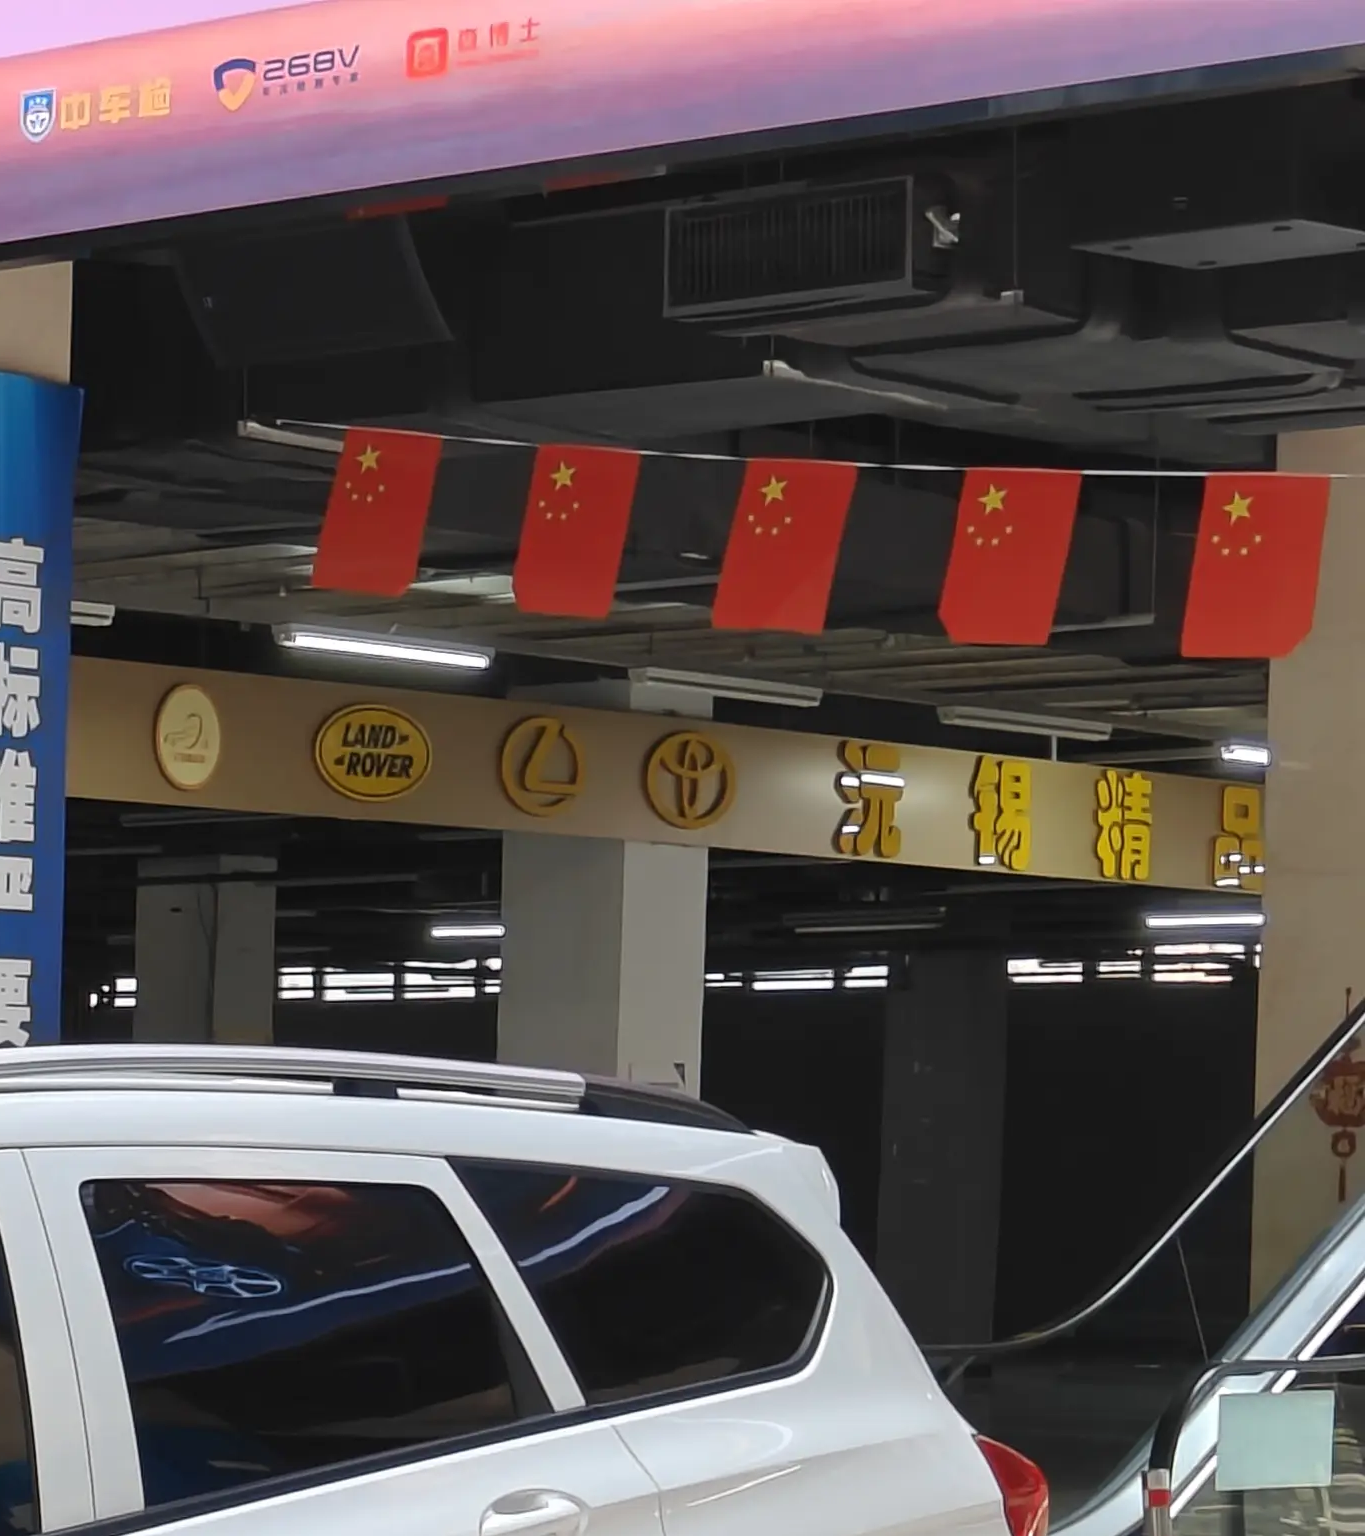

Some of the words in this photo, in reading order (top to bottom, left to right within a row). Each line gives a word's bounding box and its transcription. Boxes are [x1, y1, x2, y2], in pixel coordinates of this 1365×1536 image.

[262, 44, 360, 81] 268V
[342, 721, 397, 749] LAND
[345, 751, 414, 779] ROVER
